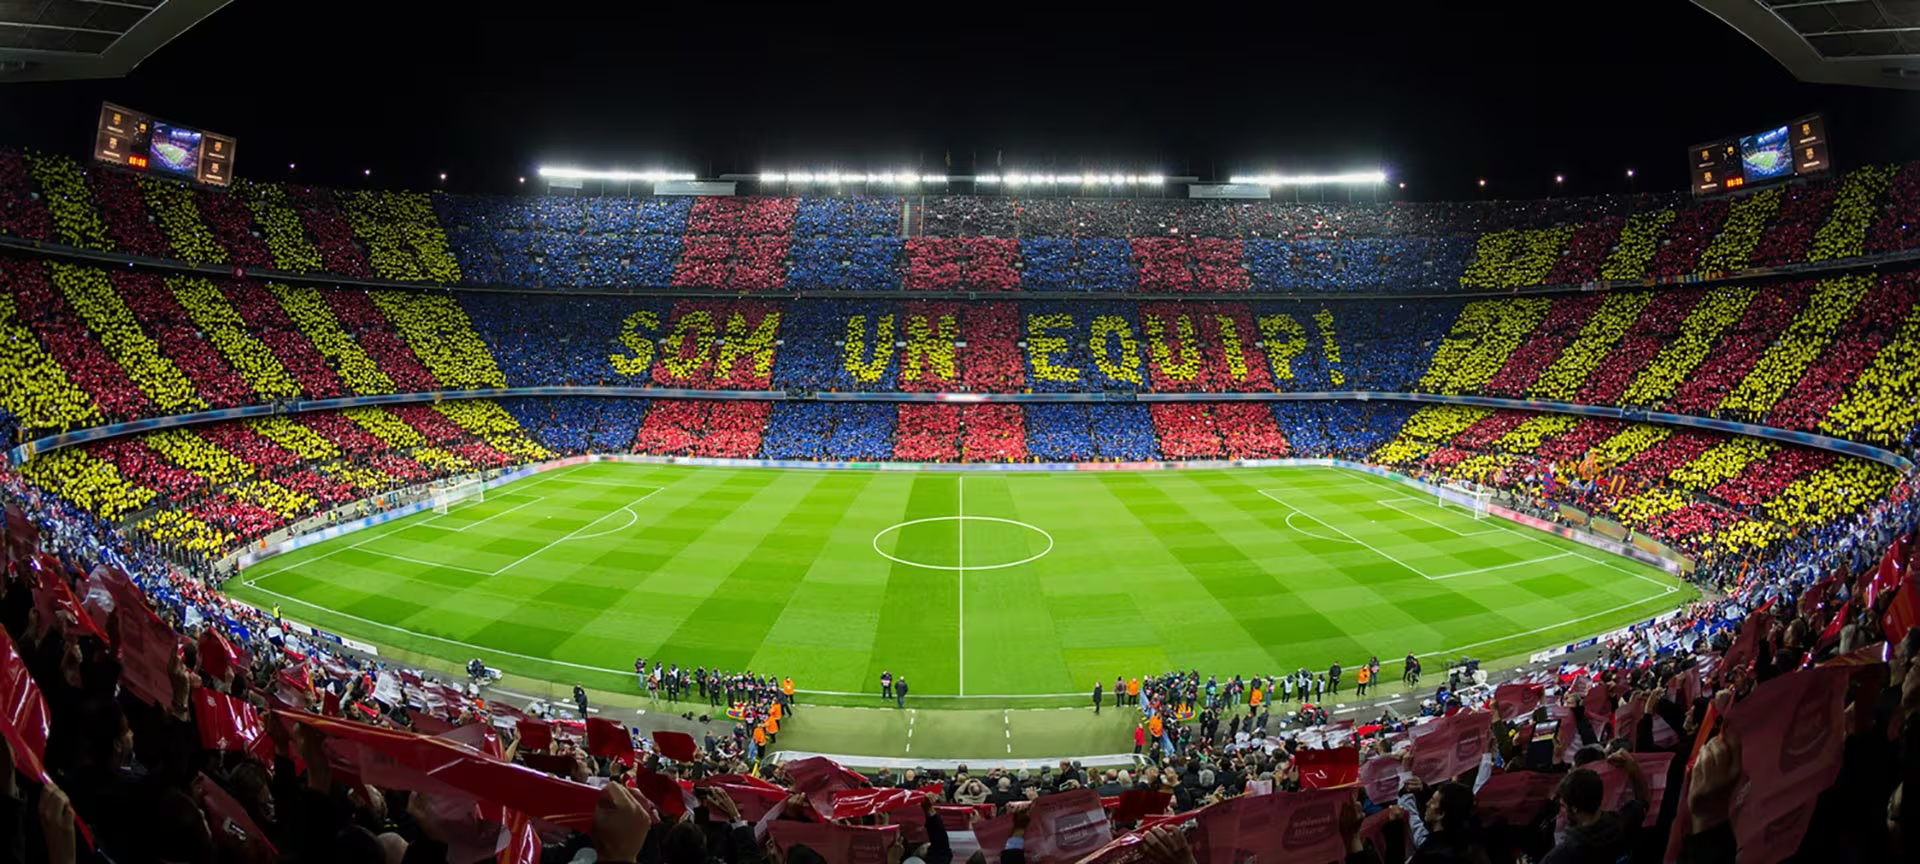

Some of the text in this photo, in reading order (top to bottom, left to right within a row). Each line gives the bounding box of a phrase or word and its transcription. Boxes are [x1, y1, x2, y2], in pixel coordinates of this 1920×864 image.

[610, 309, 1345, 386] SOM UN EQUIP!
